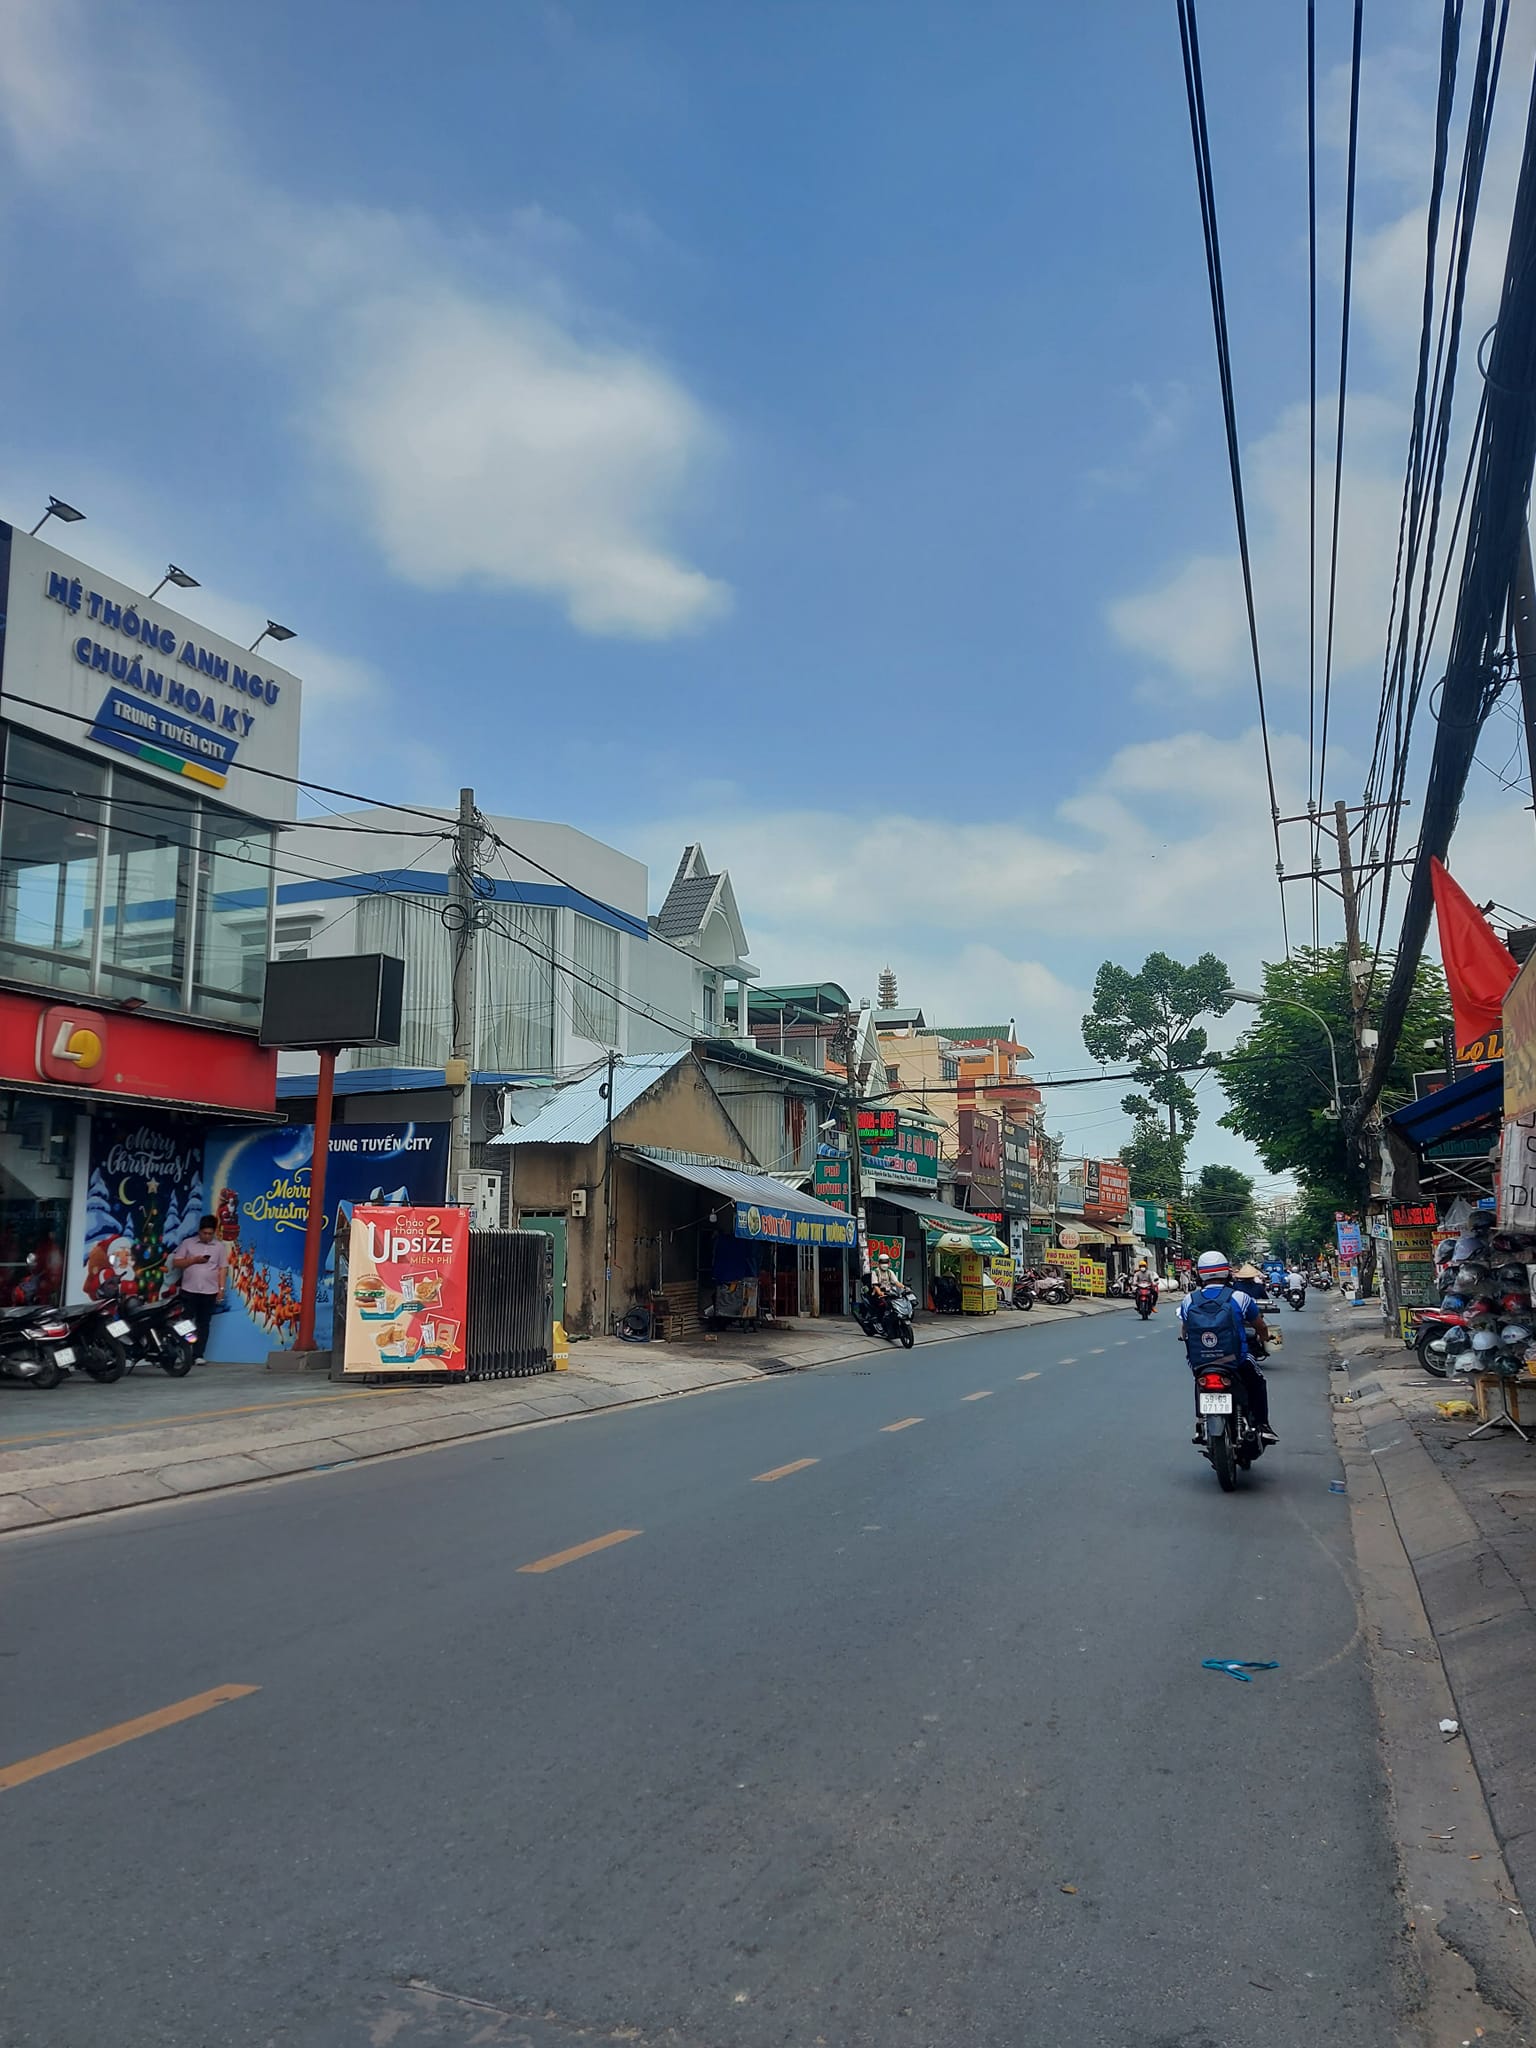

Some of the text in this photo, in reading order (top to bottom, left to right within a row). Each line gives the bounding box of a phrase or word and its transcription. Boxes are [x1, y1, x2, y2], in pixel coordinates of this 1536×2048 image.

[46, 570, 83, 616] HỆ
[87, 590, 177, 656] THỐNG
[178, 641, 229, 684] ANH
[164, 678, 216, 723] HOA
[218, 704, 256, 738] KỲ
[112, 699, 226, 759] TRUNG TUYẾN CITY
[125, 1126, 177, 1158] Merry
[327, 1134, 433, 1152] RUNG TUYẾN CITY
[266, 1178, 312, 1199] Merr
[842, 1183, 848, 1194] 2
[393, 1226, 424, 1237] tháng
[396, 1215, 442, 1235] Chào 2
